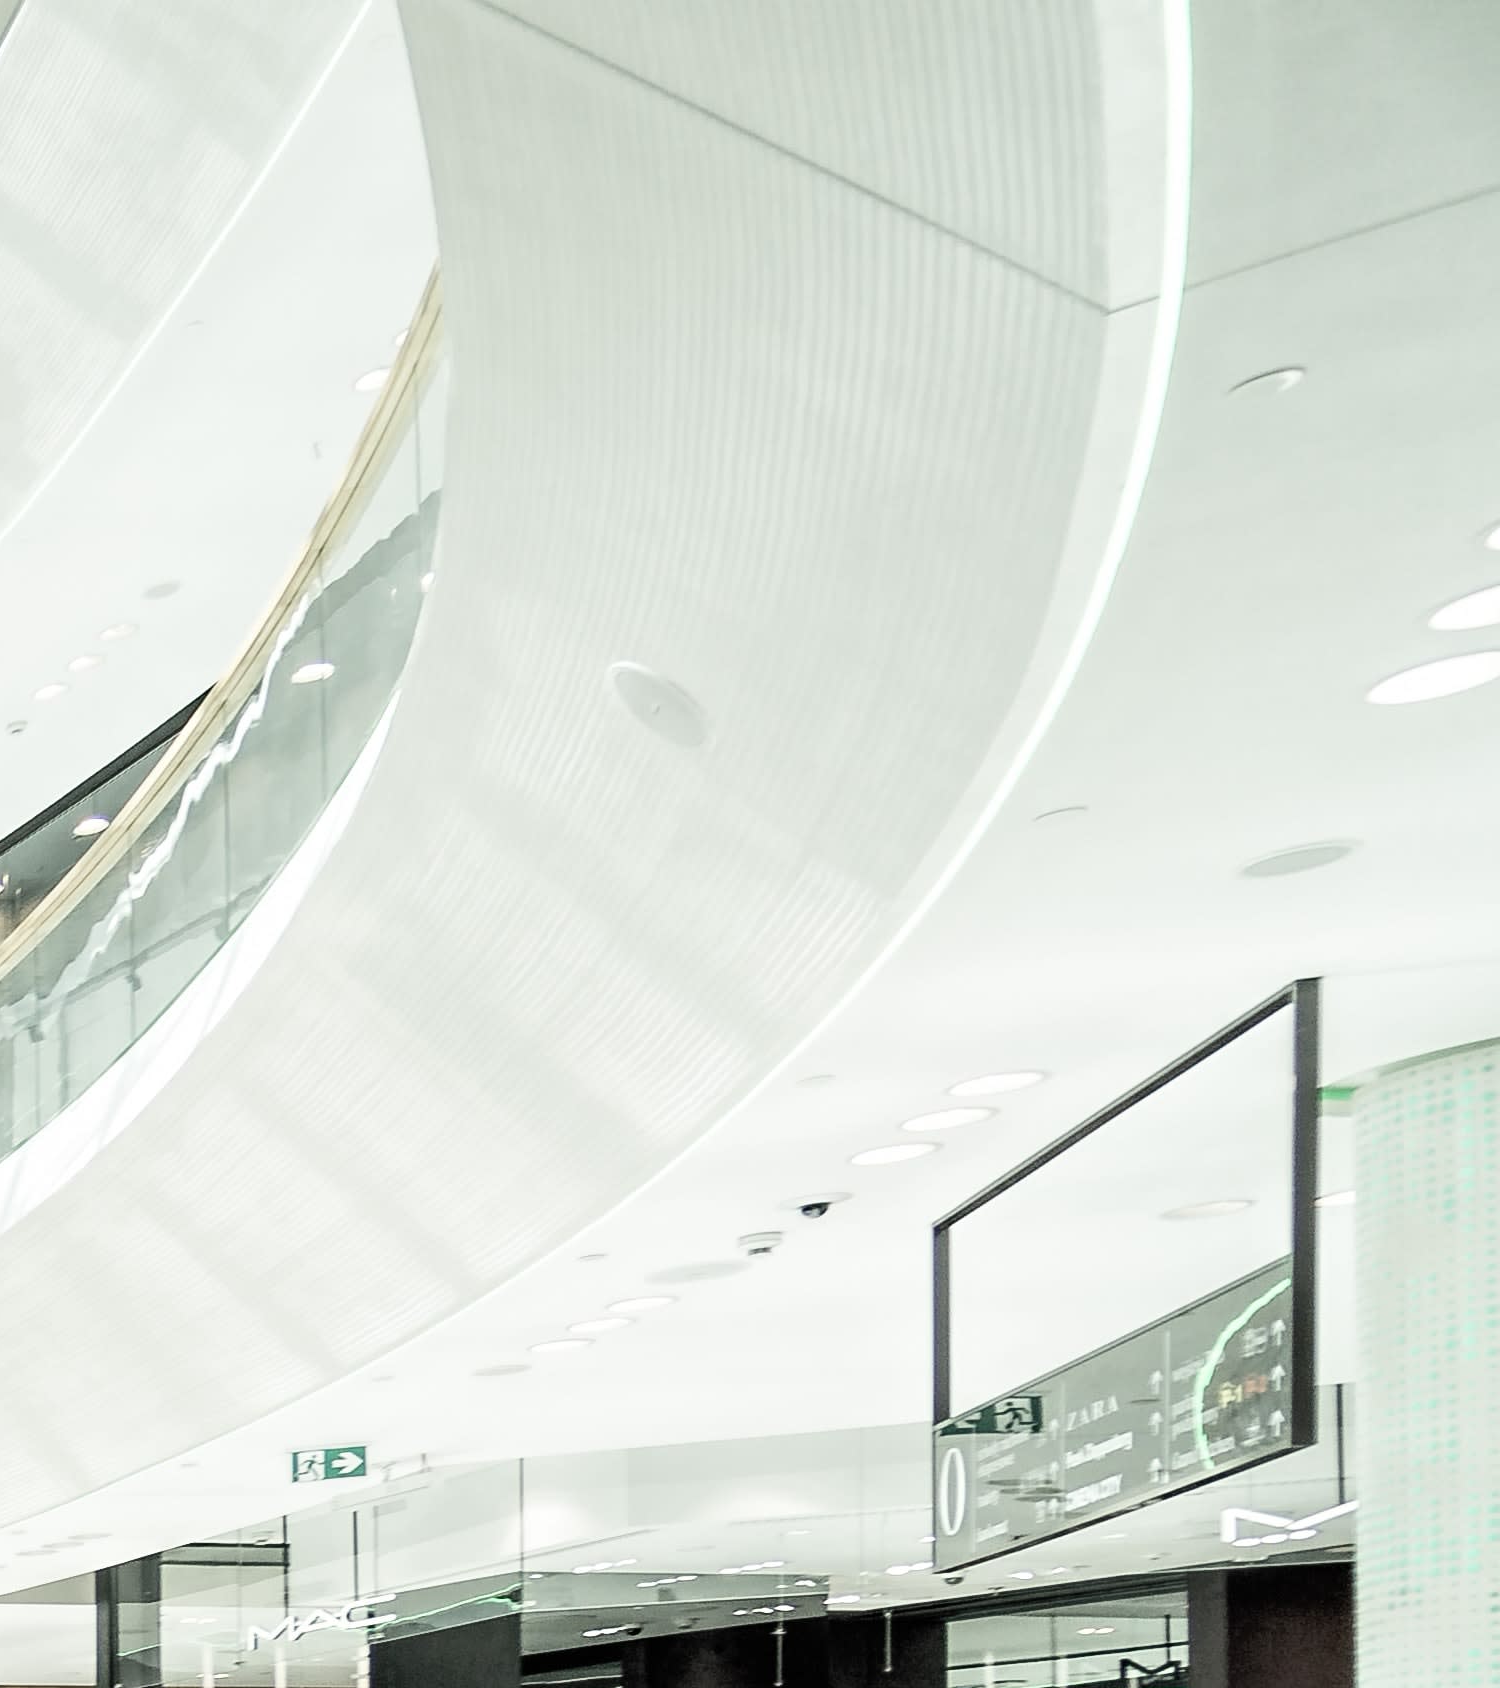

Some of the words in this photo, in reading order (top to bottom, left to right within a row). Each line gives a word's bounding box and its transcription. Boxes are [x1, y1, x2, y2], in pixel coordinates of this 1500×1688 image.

[1066, 1396, 1119, 1432] ZARA
[939, 1447, 966, 1536] 0
[248, 1593, 397, 1651] MAC
